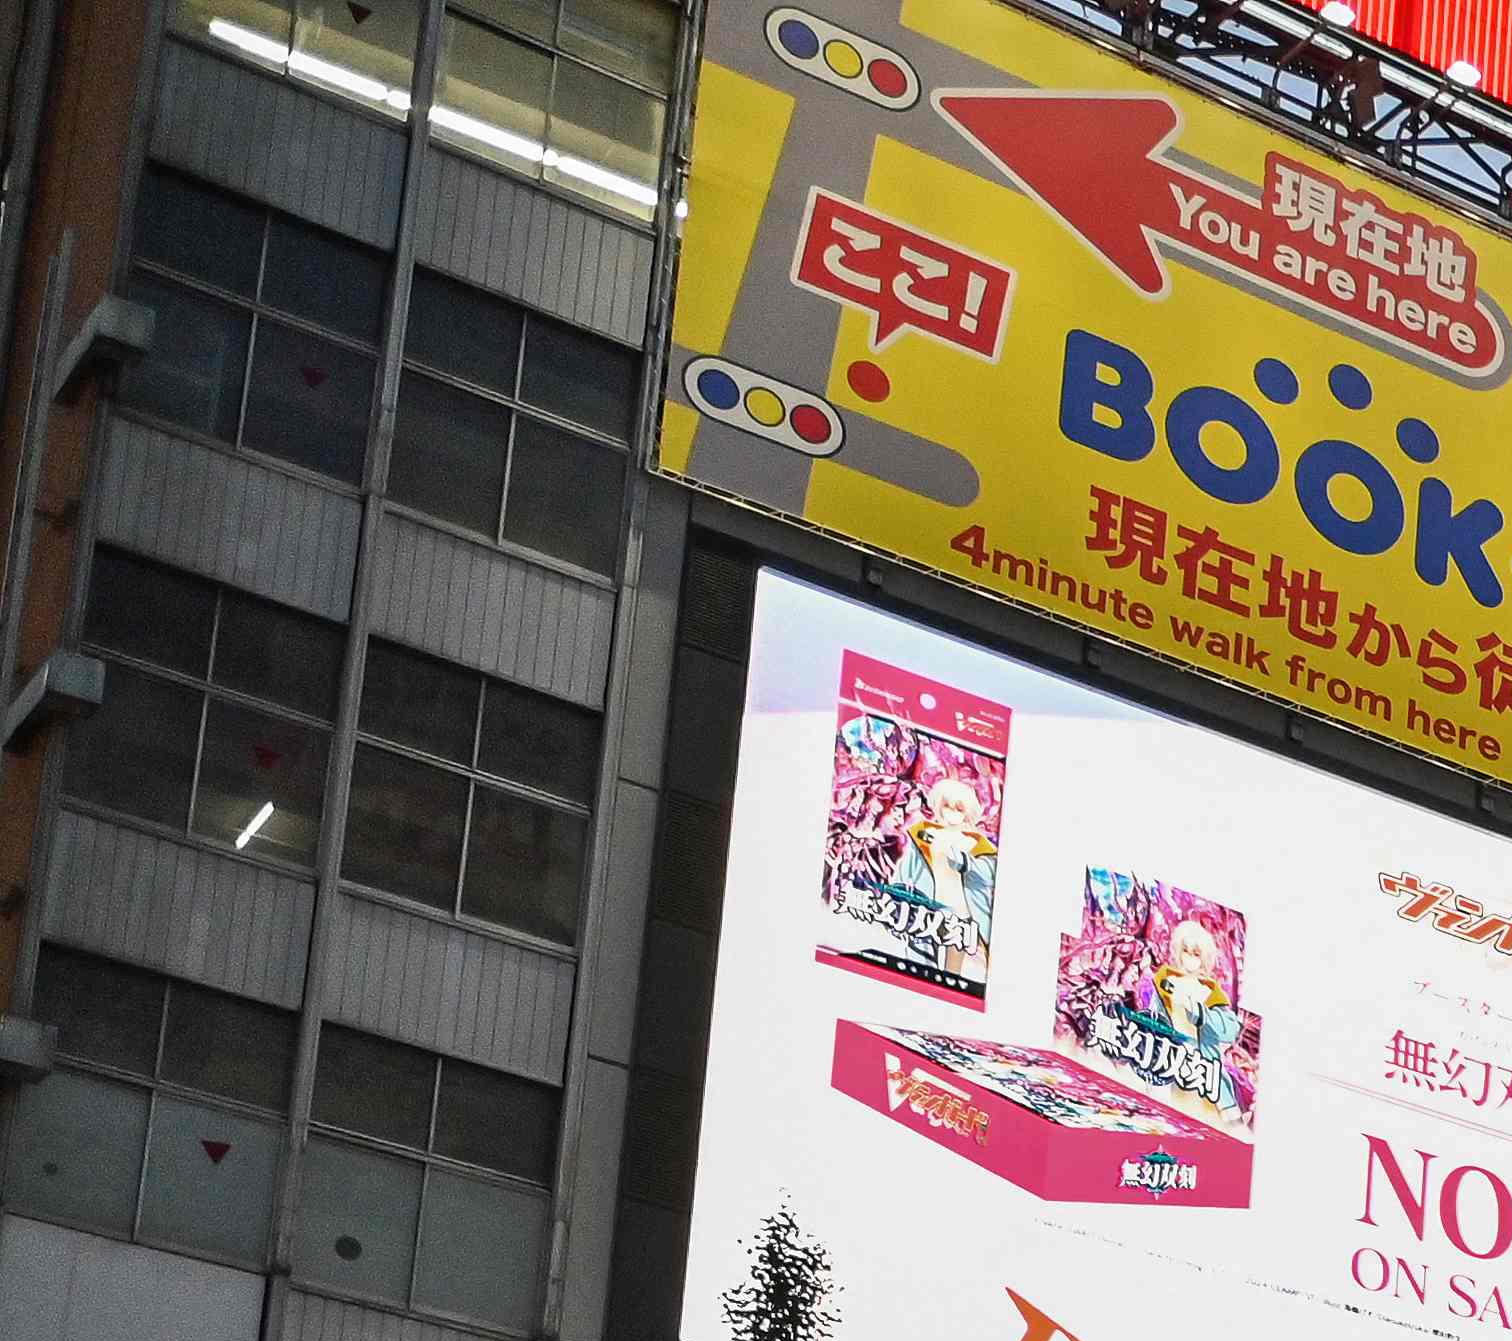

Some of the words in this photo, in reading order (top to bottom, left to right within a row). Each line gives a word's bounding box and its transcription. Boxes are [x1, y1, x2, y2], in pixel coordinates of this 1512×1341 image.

[1168, 182, 1262, 261] You
[1272, 244, 1357, 301] are
[1365, 274, 1479, 354] here
[1271, 162, 1467, 303] 現在地
[952, 525, 1154, 640] 4minute
[1168, 606, 1274, 682] walk
[1286, 650, 1394, 728] from
[1406, 700, 1505, 766] here
[1088, 1008, 1222, 1104] 無幻双刻
[1350, 1247, 1428, 1305] ON
